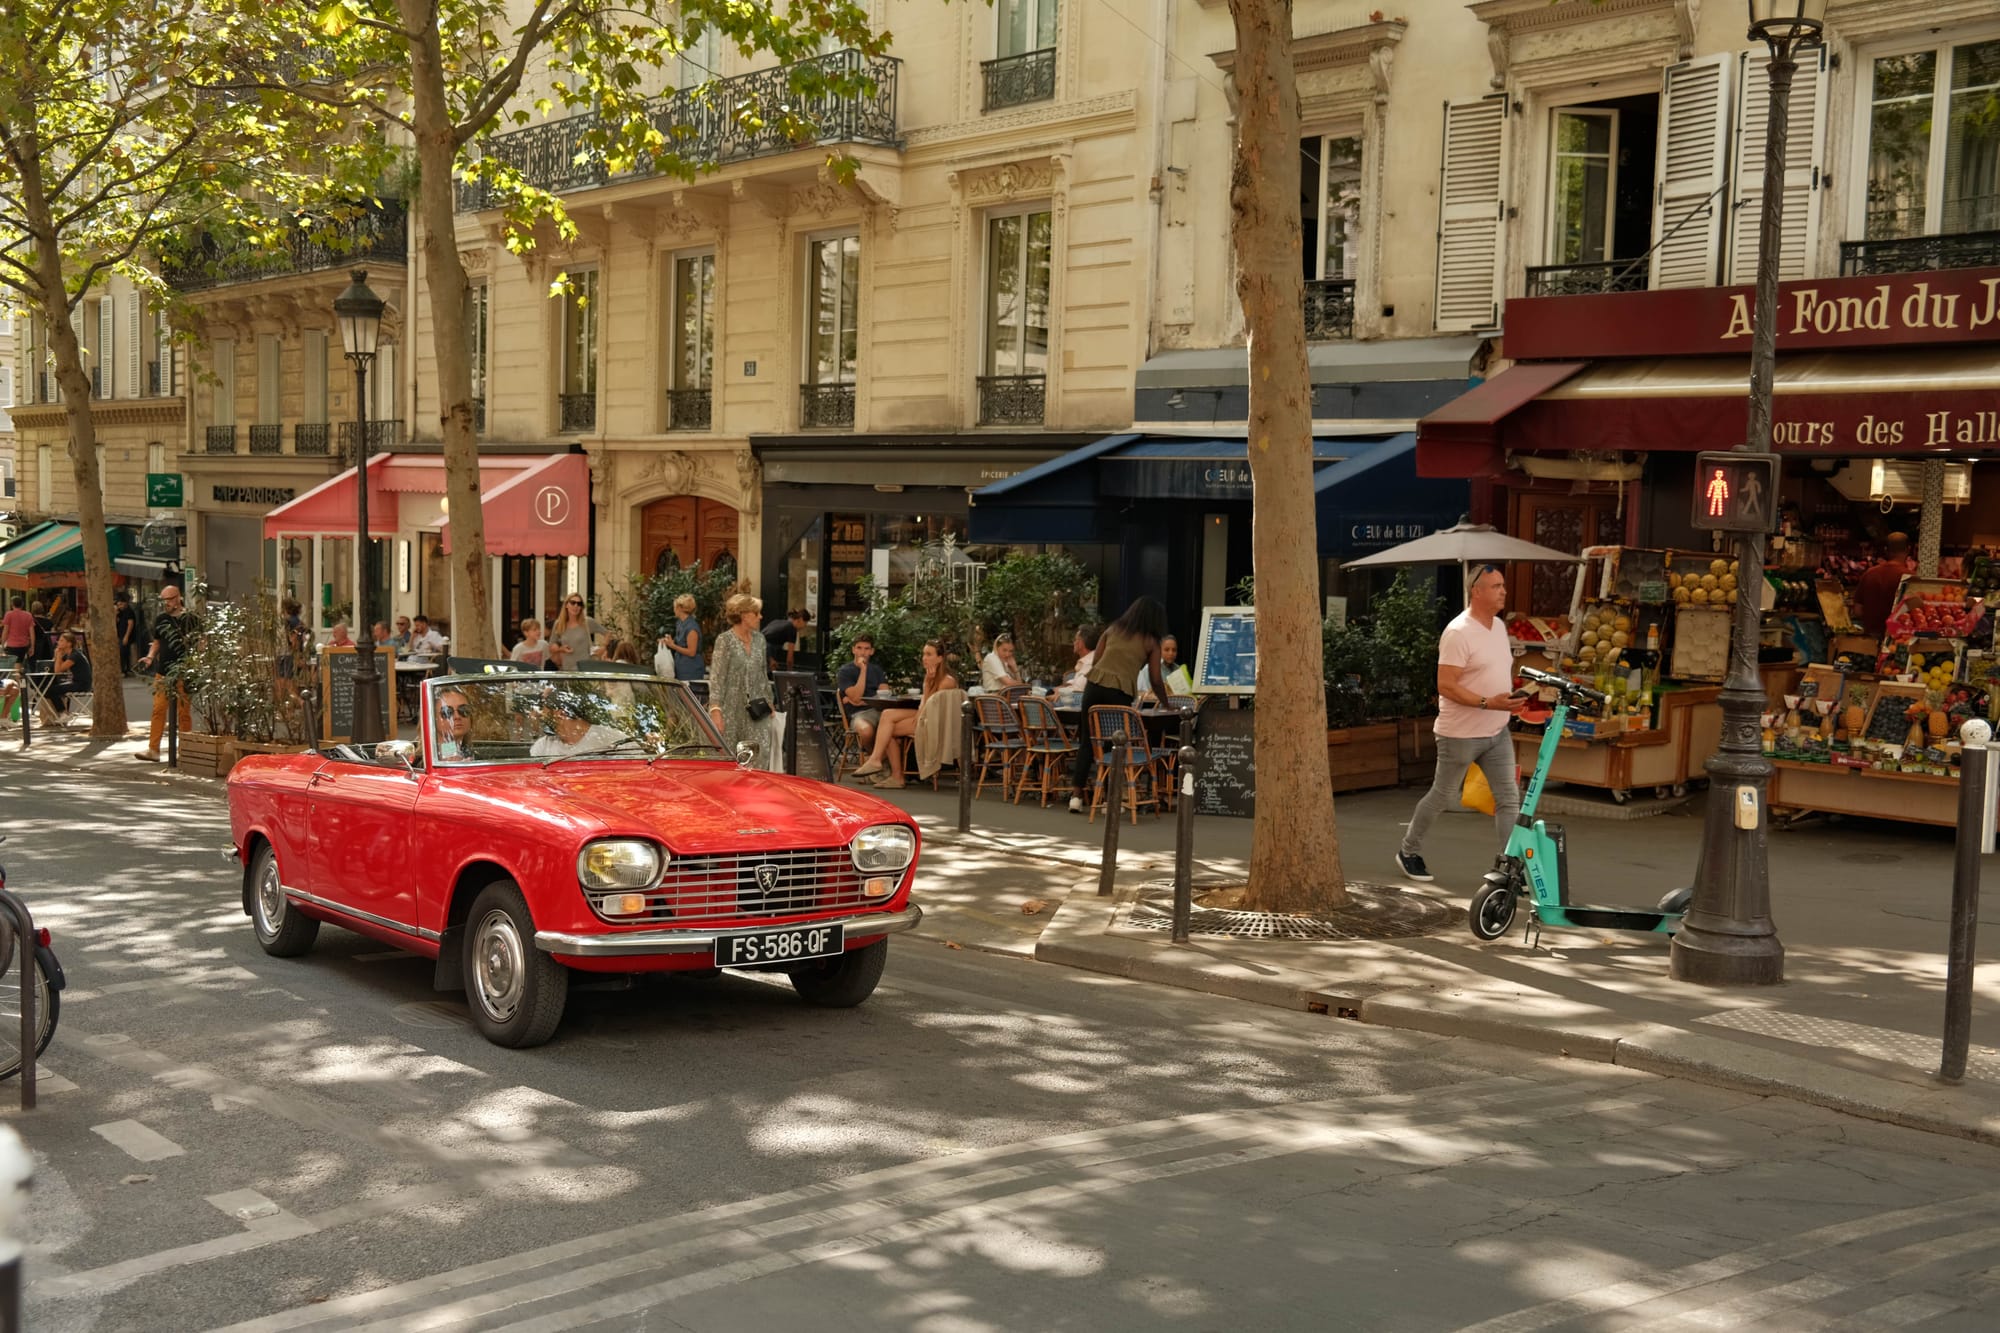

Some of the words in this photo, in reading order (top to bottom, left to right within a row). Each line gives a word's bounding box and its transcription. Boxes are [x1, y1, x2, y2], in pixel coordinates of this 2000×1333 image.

[1720, 294, 1781, 339] A
[1790, 285, 1890, 334] Fond
[1902, 283, 1961, 329] du
[1969, 278, 2000, 331] J
[1773, 421, 1835, 446] ours
[1856, 415, 1904, 445] des
[1238, 469, 1249, 482] de
[547, 493, 561, 518] P
[1383, 525, 1394, 539] de
[1523, 767, 1542, 807] TIER
[1531, 863, 1548, 899] TIER
